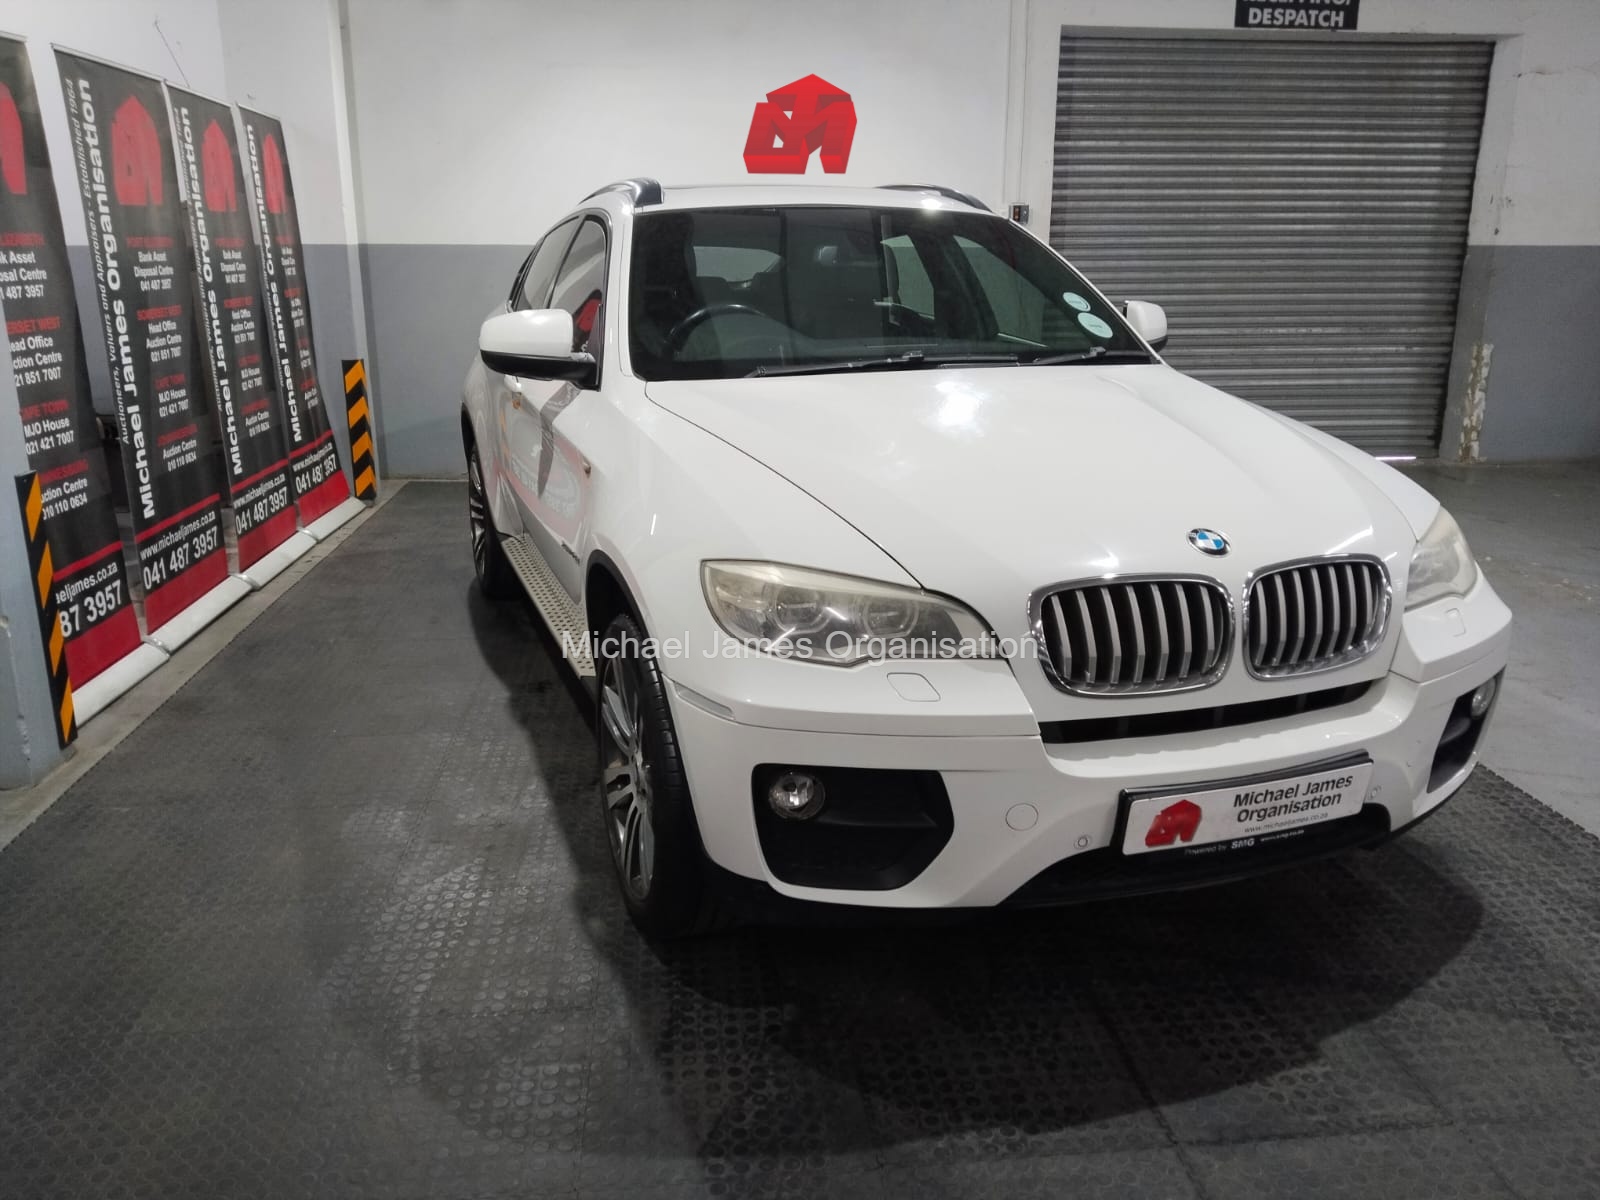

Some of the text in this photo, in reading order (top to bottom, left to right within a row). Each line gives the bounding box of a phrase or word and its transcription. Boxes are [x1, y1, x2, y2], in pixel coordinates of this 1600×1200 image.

[1248, 7, 1344, 28] DESPATCH
[65, 78, 80, 115] 1964
[72, 117, 92, 198] Established
[247, 124, 275, 276] Organisation
[10, 250, 36, 265] Asset
[88, 210, 106, 281] Appraisers
[20, 268, 47, 281] Centre
[6, 286, 22, 300] 487
[25, 284, 45, 298] 3957
[78, 78, 156, 520] Michael James Organisation
[99, 283, 110, 310] and
[181, 106, 243, 476] Michael James Organisation
[270, 282, 287, 354] James
[27, 336, 53, 350] Office
[103, 313, 117, 362] Valuers
[35, 352, 62, 366] Centre
[25, 371, 41, 385] 851
[42, 366, 62, 381] 7007
[114, 366, 130, 444] Auctioneers,
[281, 358, 302, 443] Michael
[24, 418, 70, 438] MJO House
[26, 430, 74, 455] 021 421 7007
[63, 478, 88, 494] Centre
[295, 471, 312, 494] 041
[55, 499, 70, 515] 110
[70, 492, 88, 509] 0634
[235, 486, 288, 535] 041 487 3957
[139, 511, 217, 561] www.michaeljames.co.za
[143, 526, 218, 590] 041 487 3957
[84, 579, 121, 622] 3957
[1233, 776, 1353, 807] Michael James
[1237, 793, 1342, 823] Organisation
[1231, 838, 1256, 850] SMG
